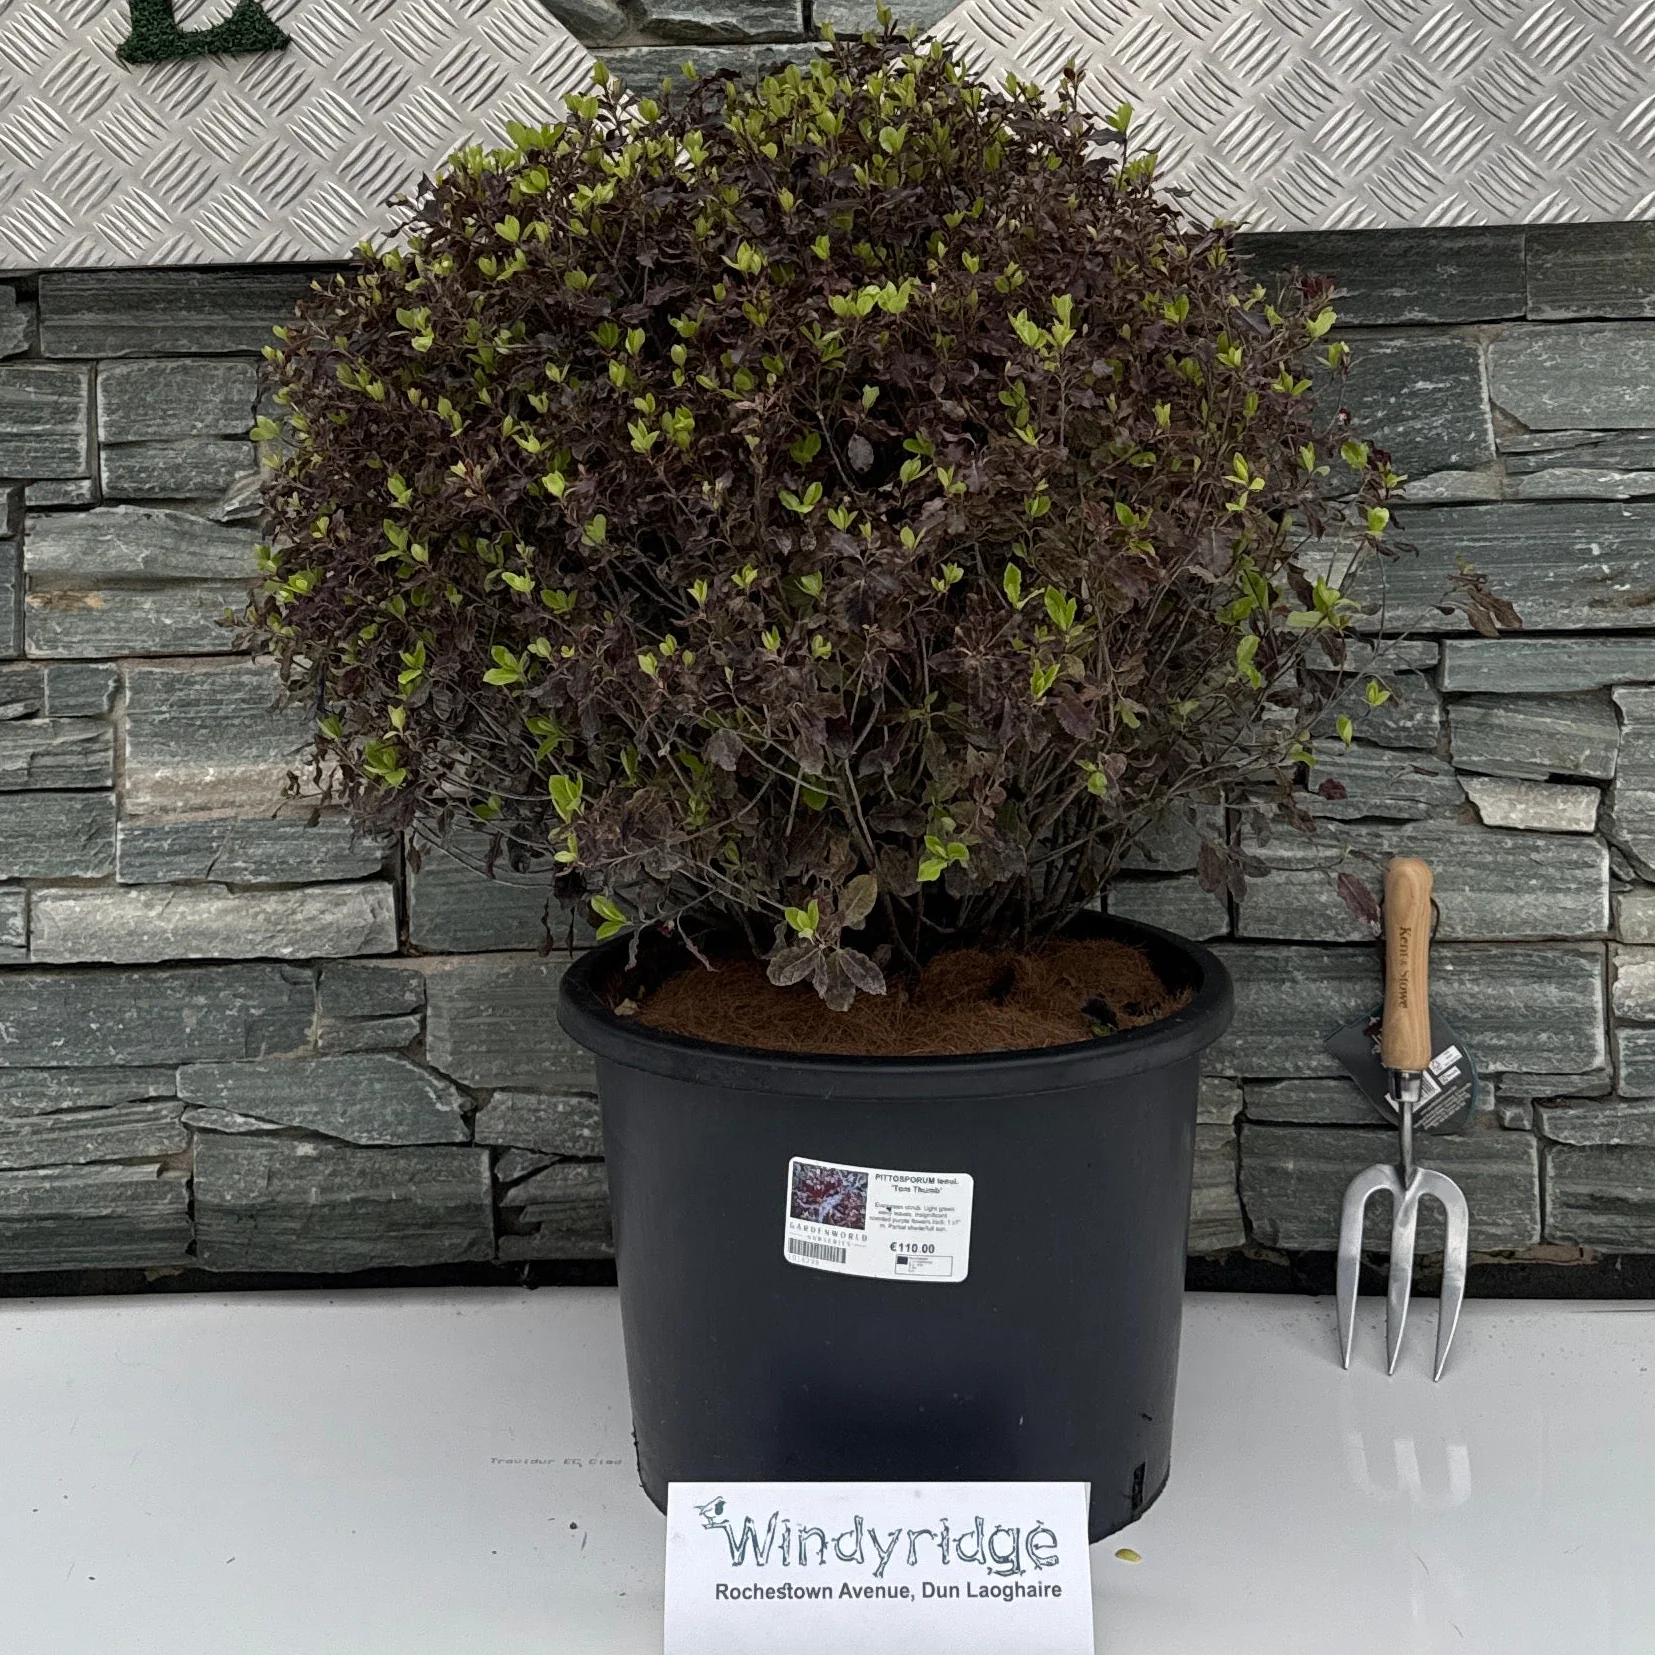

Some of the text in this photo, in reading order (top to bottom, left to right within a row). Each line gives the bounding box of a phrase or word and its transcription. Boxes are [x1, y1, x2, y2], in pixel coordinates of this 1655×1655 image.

[1399, 926, 1412, 958] Kent
[1398, 969, 1410, 1009] Stowe
[875, 1173, 936, 1185] PITTOSPORUM
[789, 1221, 868, 1242] GARDENWORLD
[708, 1510, 1059, 1578] Windyridge
[715, 1580, 1063, 1602] Rochestown Avenue, Dun Laoghaire
